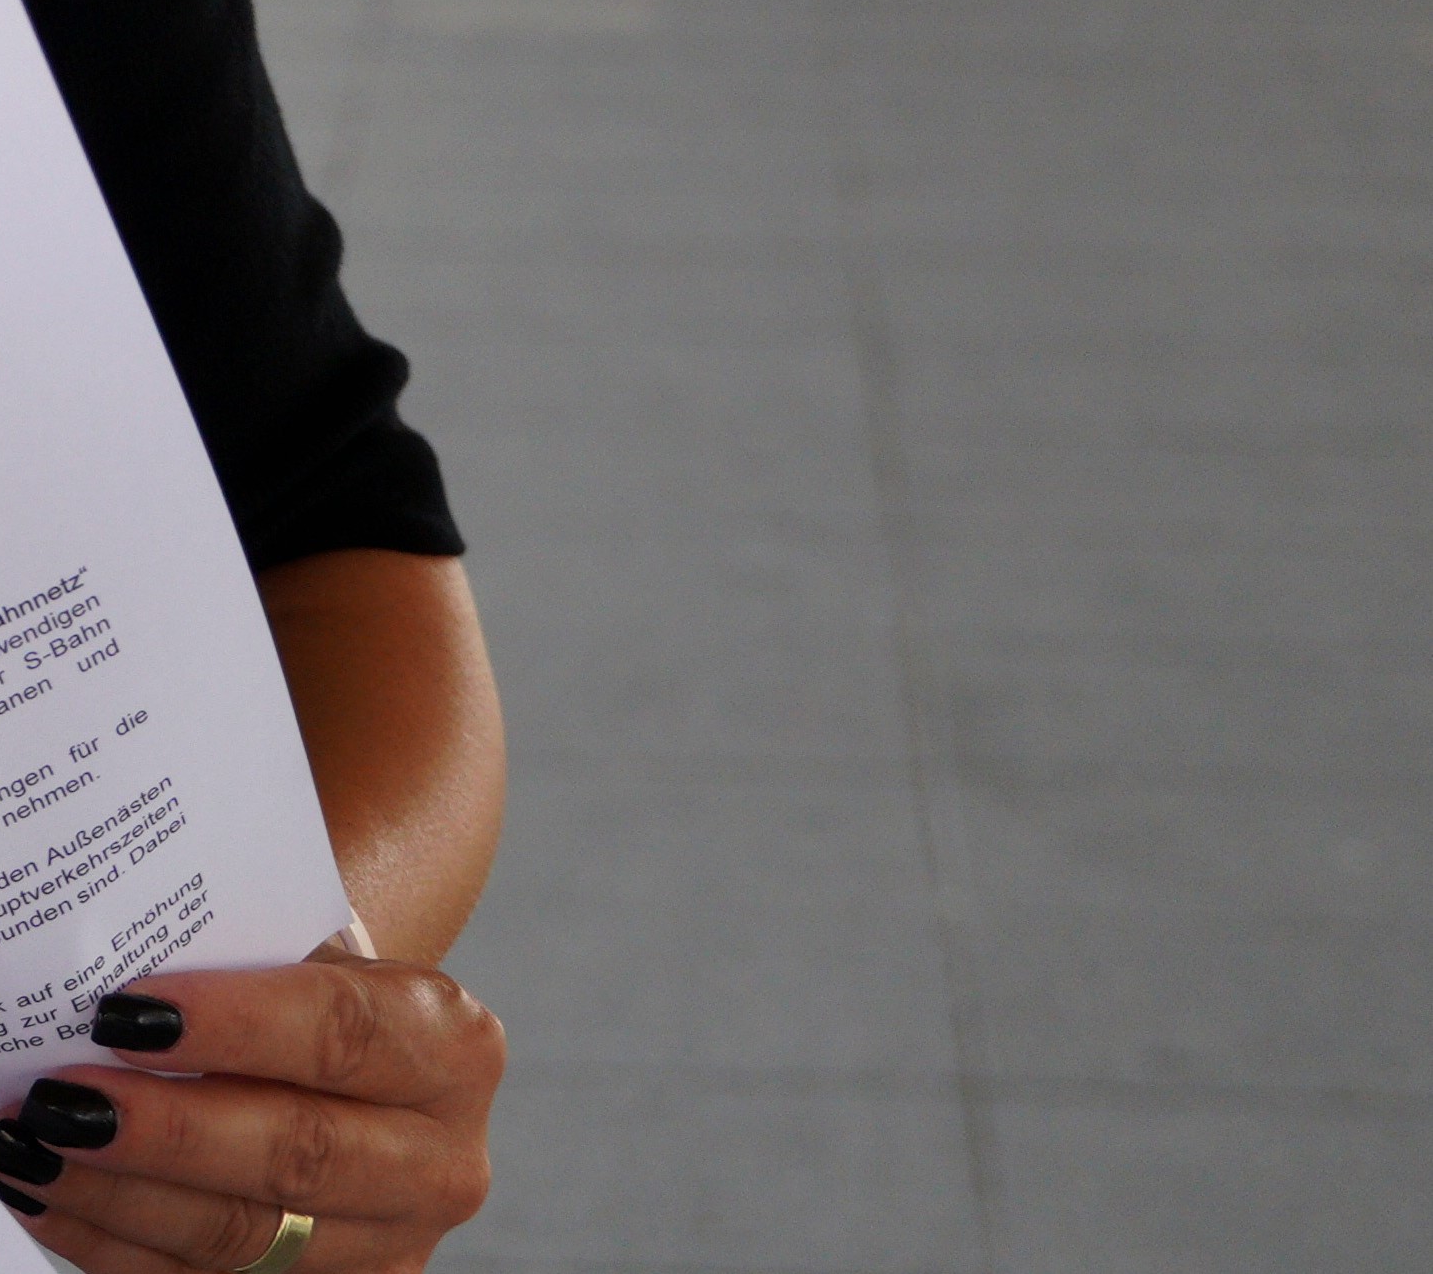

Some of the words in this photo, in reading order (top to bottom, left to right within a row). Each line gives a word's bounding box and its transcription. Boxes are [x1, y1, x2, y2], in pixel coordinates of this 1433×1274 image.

[23, 617, 111, 670] S-Bahn
[76, 637, 120, 673] und
[69, 737, 101, 763] für
[115, 707, 149, 736] die
[2, 769, 101, 827] nehmen.
[47, 776, 172, 866] Außenästen
[77, 864, 125, 904] sind.
[128, 812, 187, 866] Dabei
[16, 983, 57, 1008] auf
[63, 954, 105, 992] eine
[110, 871, 203, 952] Erhöhung
[21, 1008, 57, 1029] zur
[70, 923, 169, 1013] Einhaltung
[178, 889, 208, 921] der
